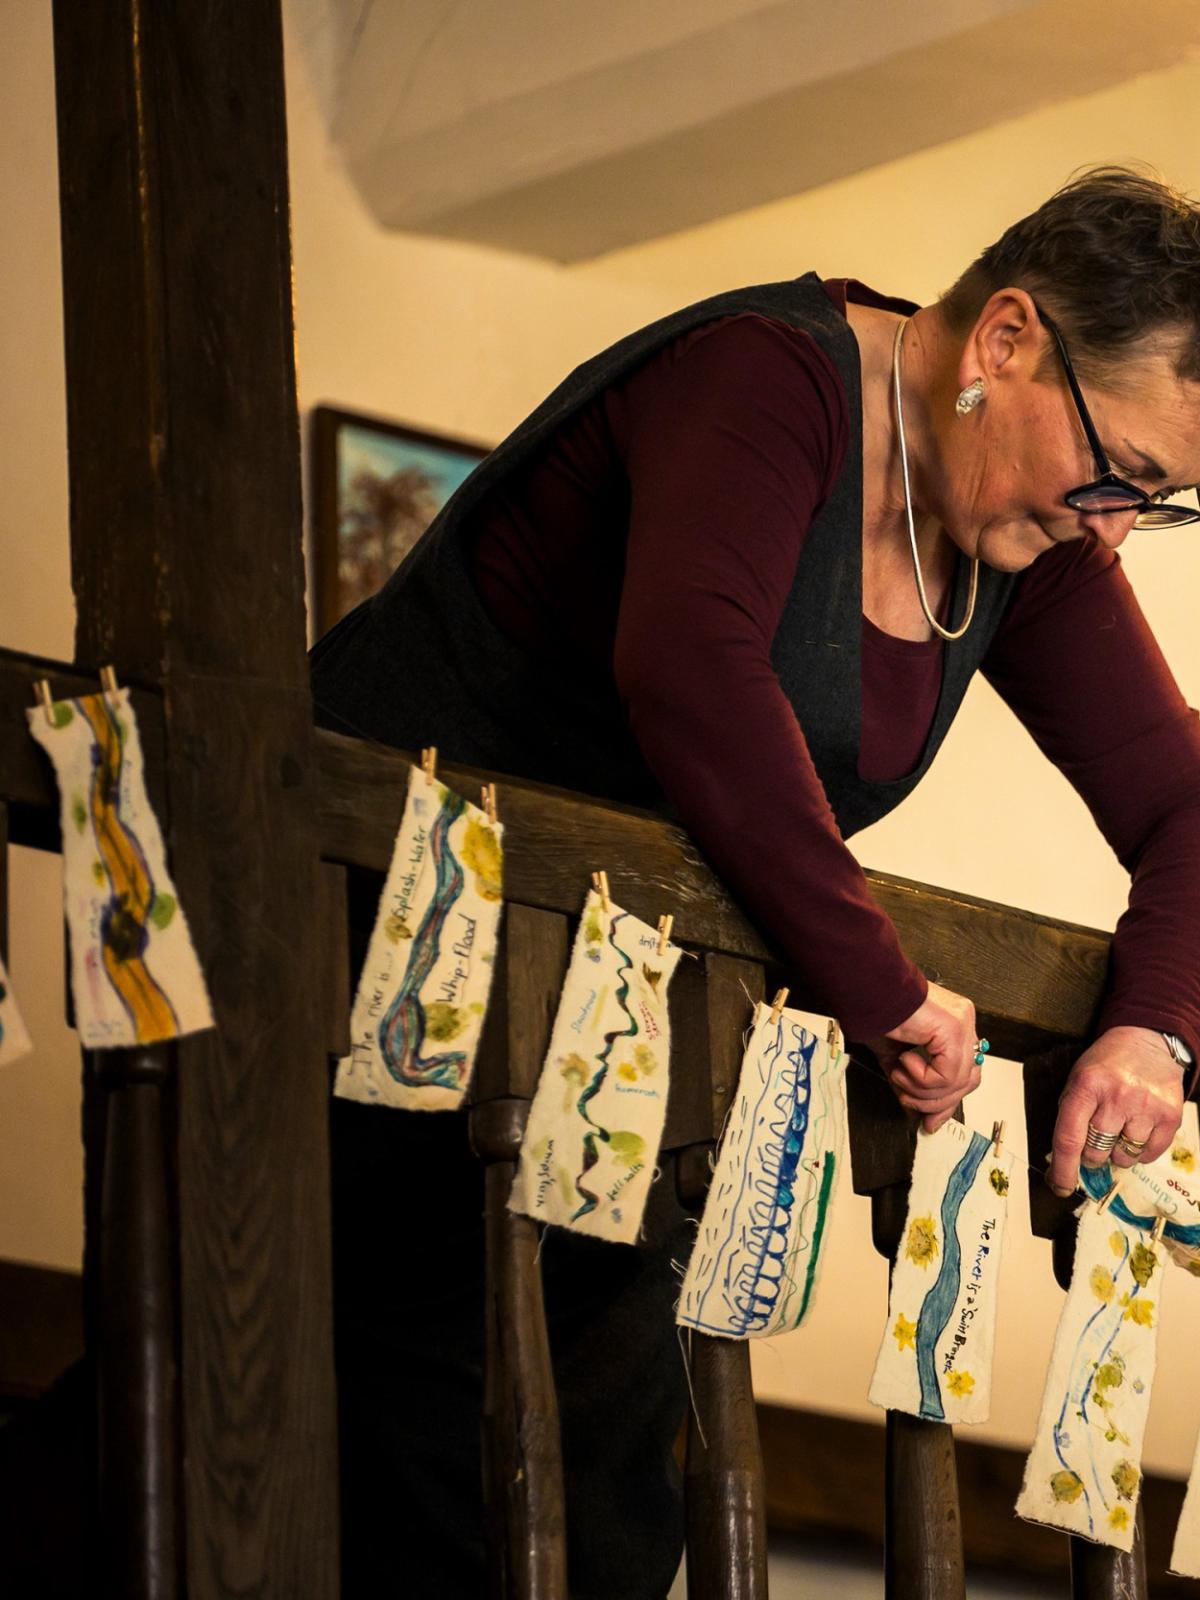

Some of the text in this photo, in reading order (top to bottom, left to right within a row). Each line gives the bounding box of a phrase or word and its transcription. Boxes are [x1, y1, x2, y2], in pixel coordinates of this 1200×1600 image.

[346, 1031, 375, 1078] The
[368, 989, 385, 1018] river
[980, 1218, 996, 1241] The
[971, 1244, 990, 1281] River
[966, 1283, 982, 1296] is
[966, 1296, 976, 1305] a
